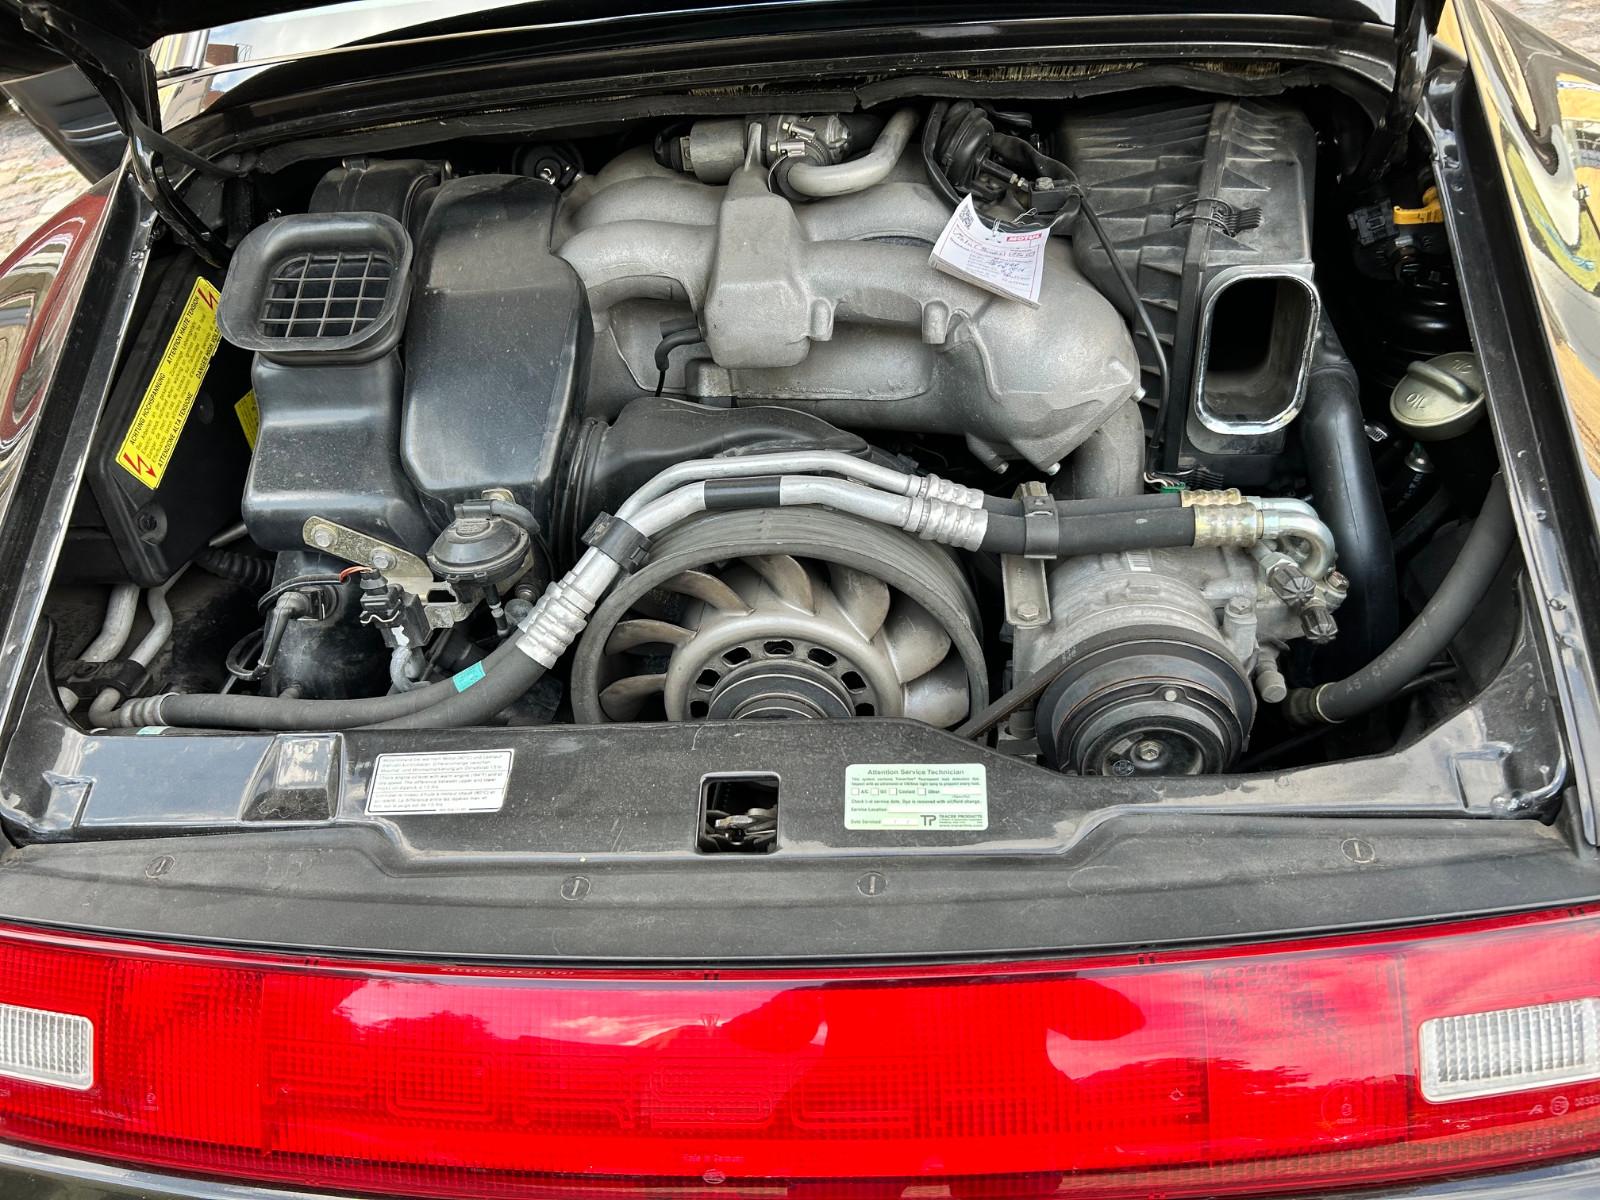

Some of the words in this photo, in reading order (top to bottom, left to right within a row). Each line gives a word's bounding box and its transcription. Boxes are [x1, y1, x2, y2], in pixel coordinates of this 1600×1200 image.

[166, 335, 182, 365] ATTENTION
[180, 318, 190, 336] HAUTE
[188, 296, 200, 318] TENSION
[195, 356, 208, 379] DANGER
[205, 342, 214, 357] HIGH
[130, 417, 145, 446] ACHTUNG
[142, 372, 166, 418] HOCHSPANNUNG
[1406, 391, 1425, 410] OIL
[156, 432, 175, 467] ATTENZIONE
[171, 417, 181, 433] ALTA
[178, 391, 193, 418] TENSIONE
[920, 814, 937, 826] TP
